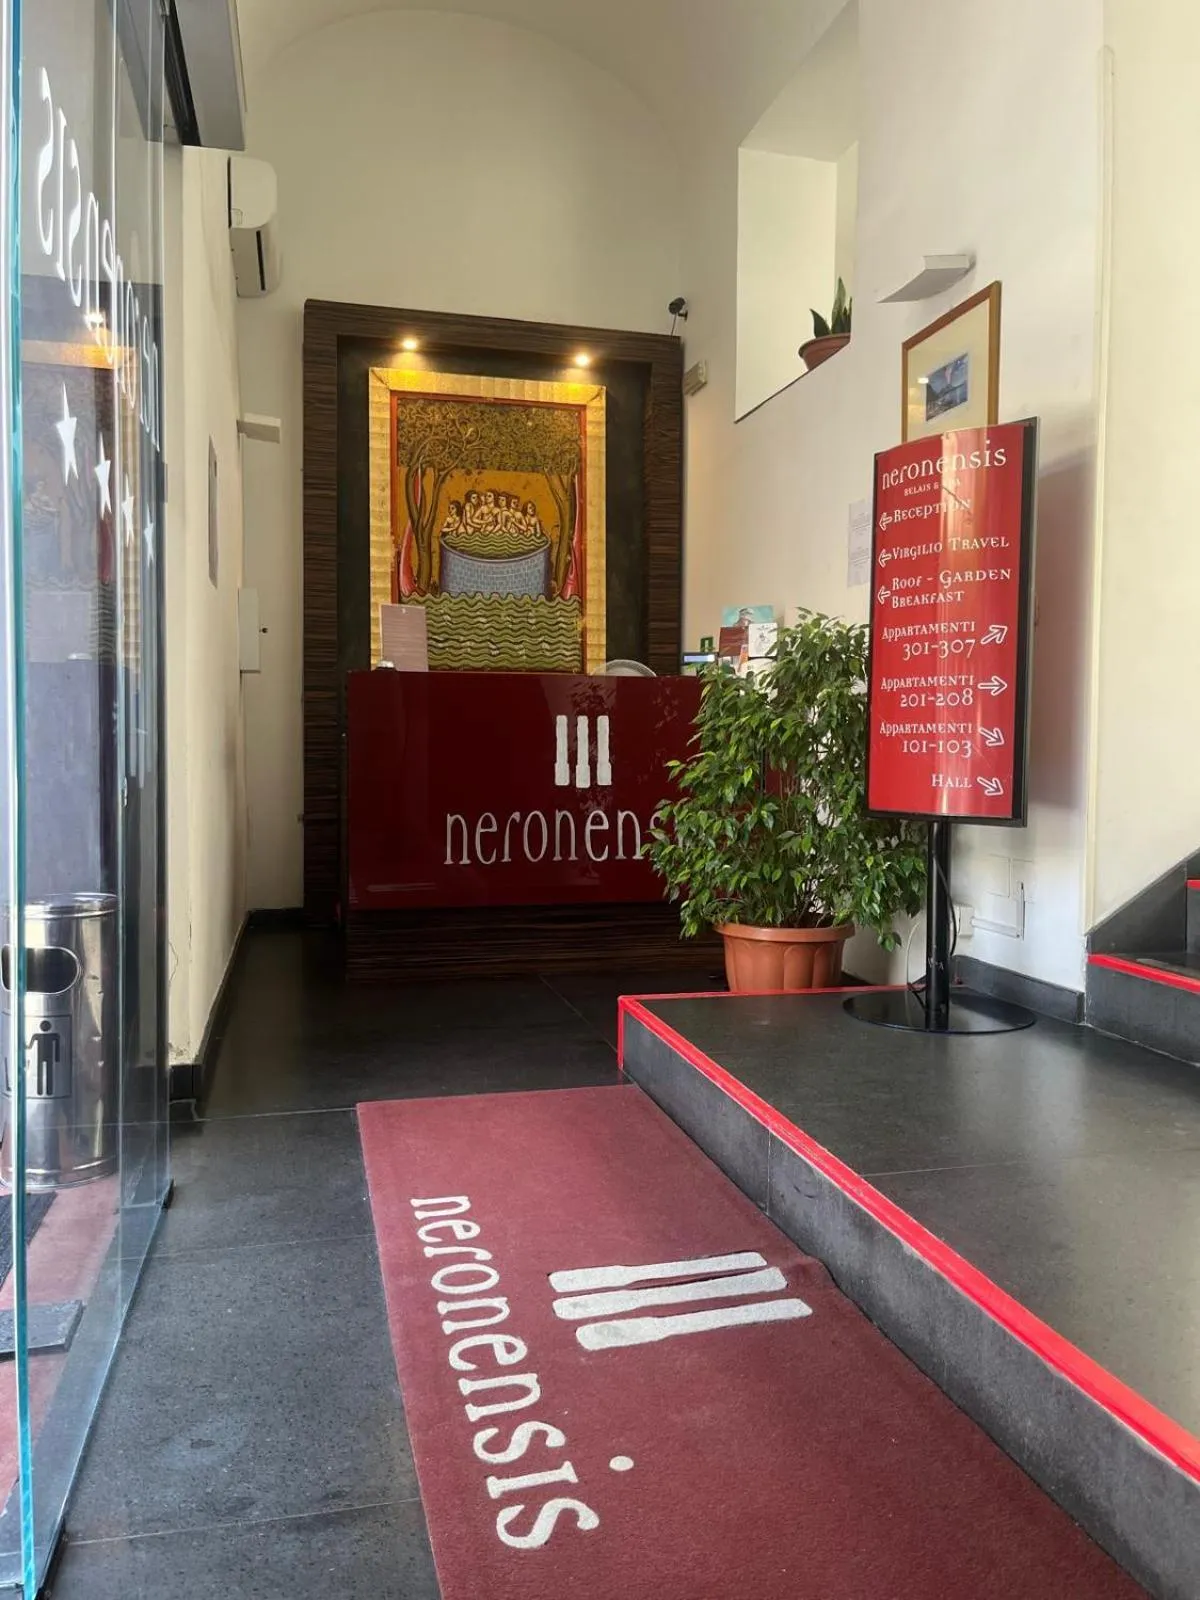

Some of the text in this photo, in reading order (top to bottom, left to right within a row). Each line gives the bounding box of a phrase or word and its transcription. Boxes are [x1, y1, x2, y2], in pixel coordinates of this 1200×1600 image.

[882, 440, 1007, 490] neronensis
[893, 498, 972, 523] RECEPTION
[891, 536, 1010, 562] VIRGILIO TRAVEL
[892, 576, 922, 590] ROOF
[939, 568, 1012, 589] GARDEN
[892, 591, 965, 609] BREAKFAST
[882, 621, 976, 642] APPARTAMENTI
[902, 639, 976, 661] 301-307
[880, 675, 974, 692] APPARTAMENTI
[900, 687, 974, 707] 201-208
[879, 722, 973, 736] APPARTAMENTI
[902, 740, 972, 758] 101-103
[931, 774, 973, 788] HALL
[410, 1195, 634, 1549] neronensis
